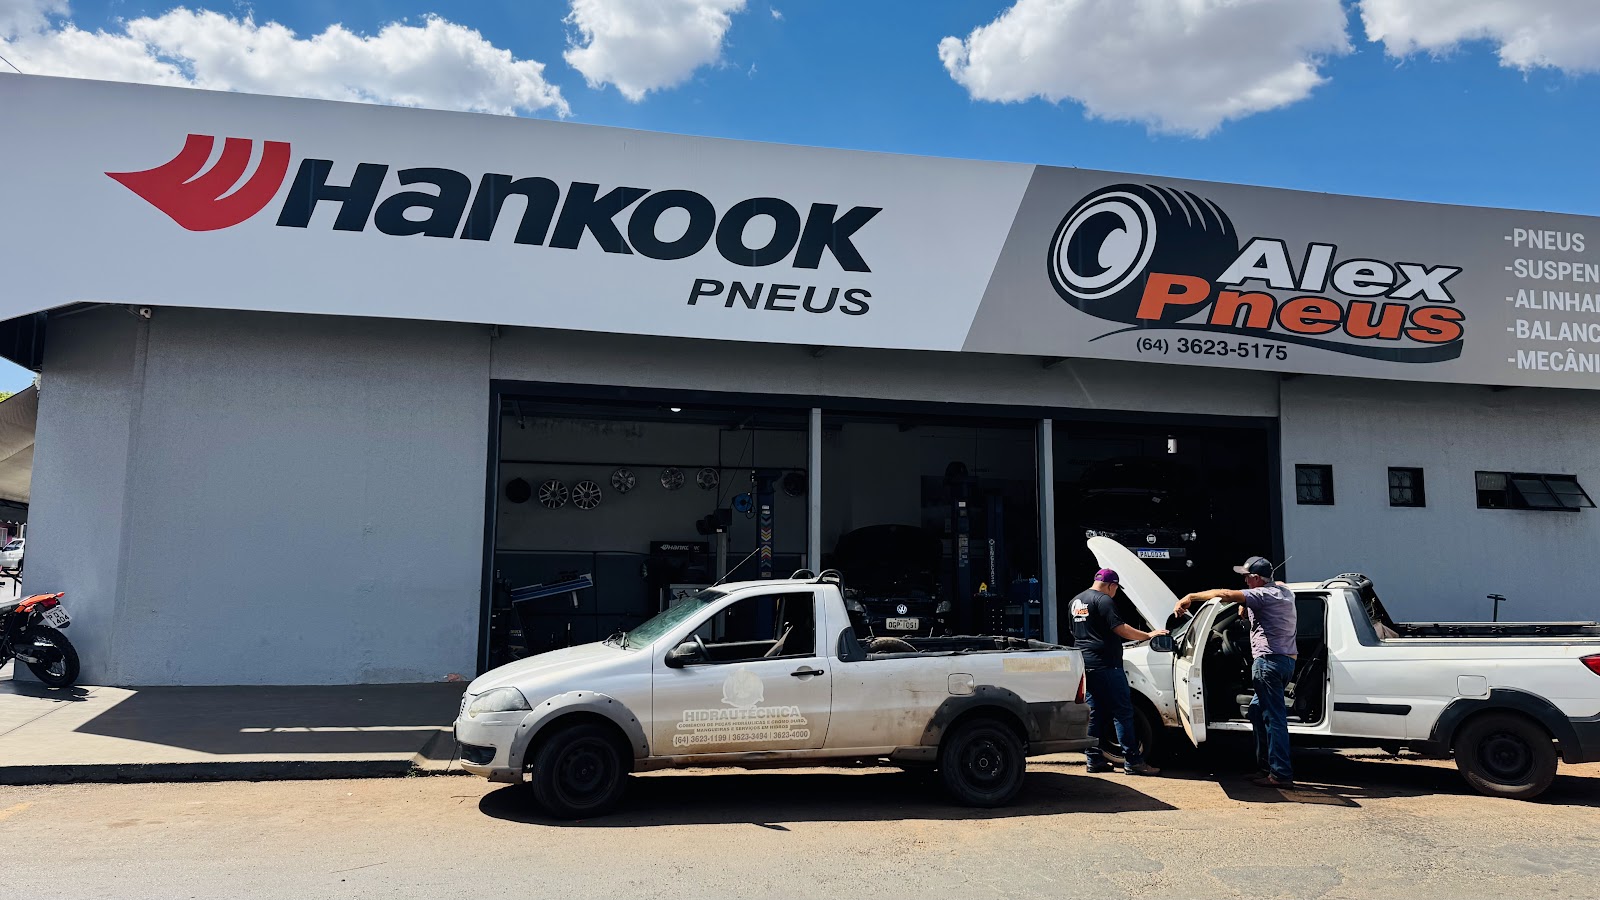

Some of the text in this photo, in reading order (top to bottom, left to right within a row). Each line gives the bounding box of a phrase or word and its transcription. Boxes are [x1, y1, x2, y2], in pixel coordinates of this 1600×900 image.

[1215, 237, 1463, 303] Alex
[687, 278, 873, 317] PNEUS
[1136, 272, 1465, 343] Pneus
[1505, 288, 1600, 313] -ALINHA
[1136, 337, 1288, 361] (64) 3623-5175
[685, 706, 800, 721] HIDRAUTÉCNICA
[675, 736, 689, 745] (64)
[690, 735, 727, 743] 3623-1199
[732, 733, 767, 741] 3623-3494
[773, 730, 808, 739] 3623-4000
